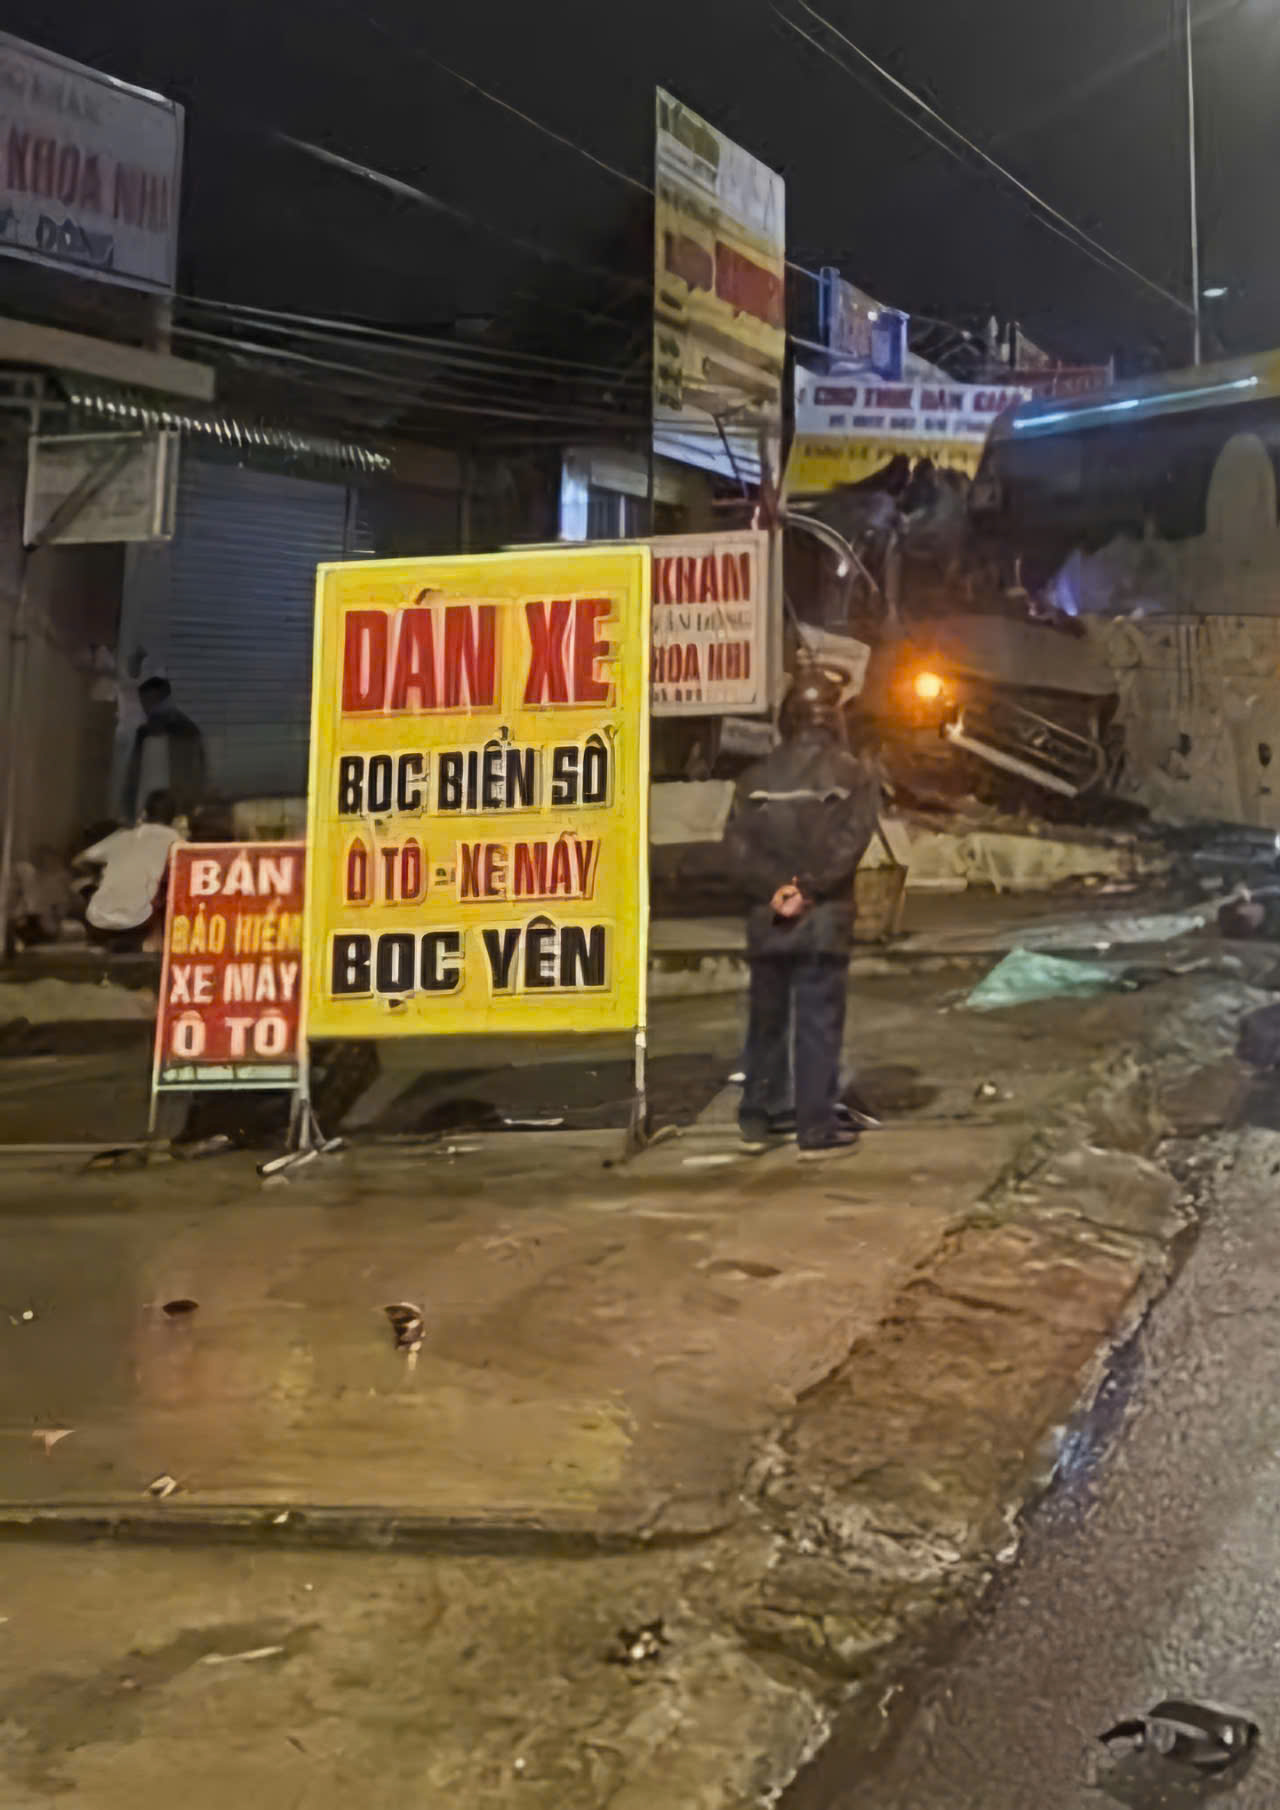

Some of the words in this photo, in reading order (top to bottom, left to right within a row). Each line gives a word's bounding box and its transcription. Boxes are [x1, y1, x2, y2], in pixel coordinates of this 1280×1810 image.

[522, 597, 613, 704] XE
[189, 849, 294, 896] BÁN
[381, 837, 422, 901] TÔ
[460, 842, 508, 897] XE
[169, 963, 214, 1004] XE
[332, 931, 461, 1009] BỌC
[482, 914, 606, 989] YÊN
[172, 1009, 206, 1057] Ô
[224, 1008, 287, 1057] TÔ
